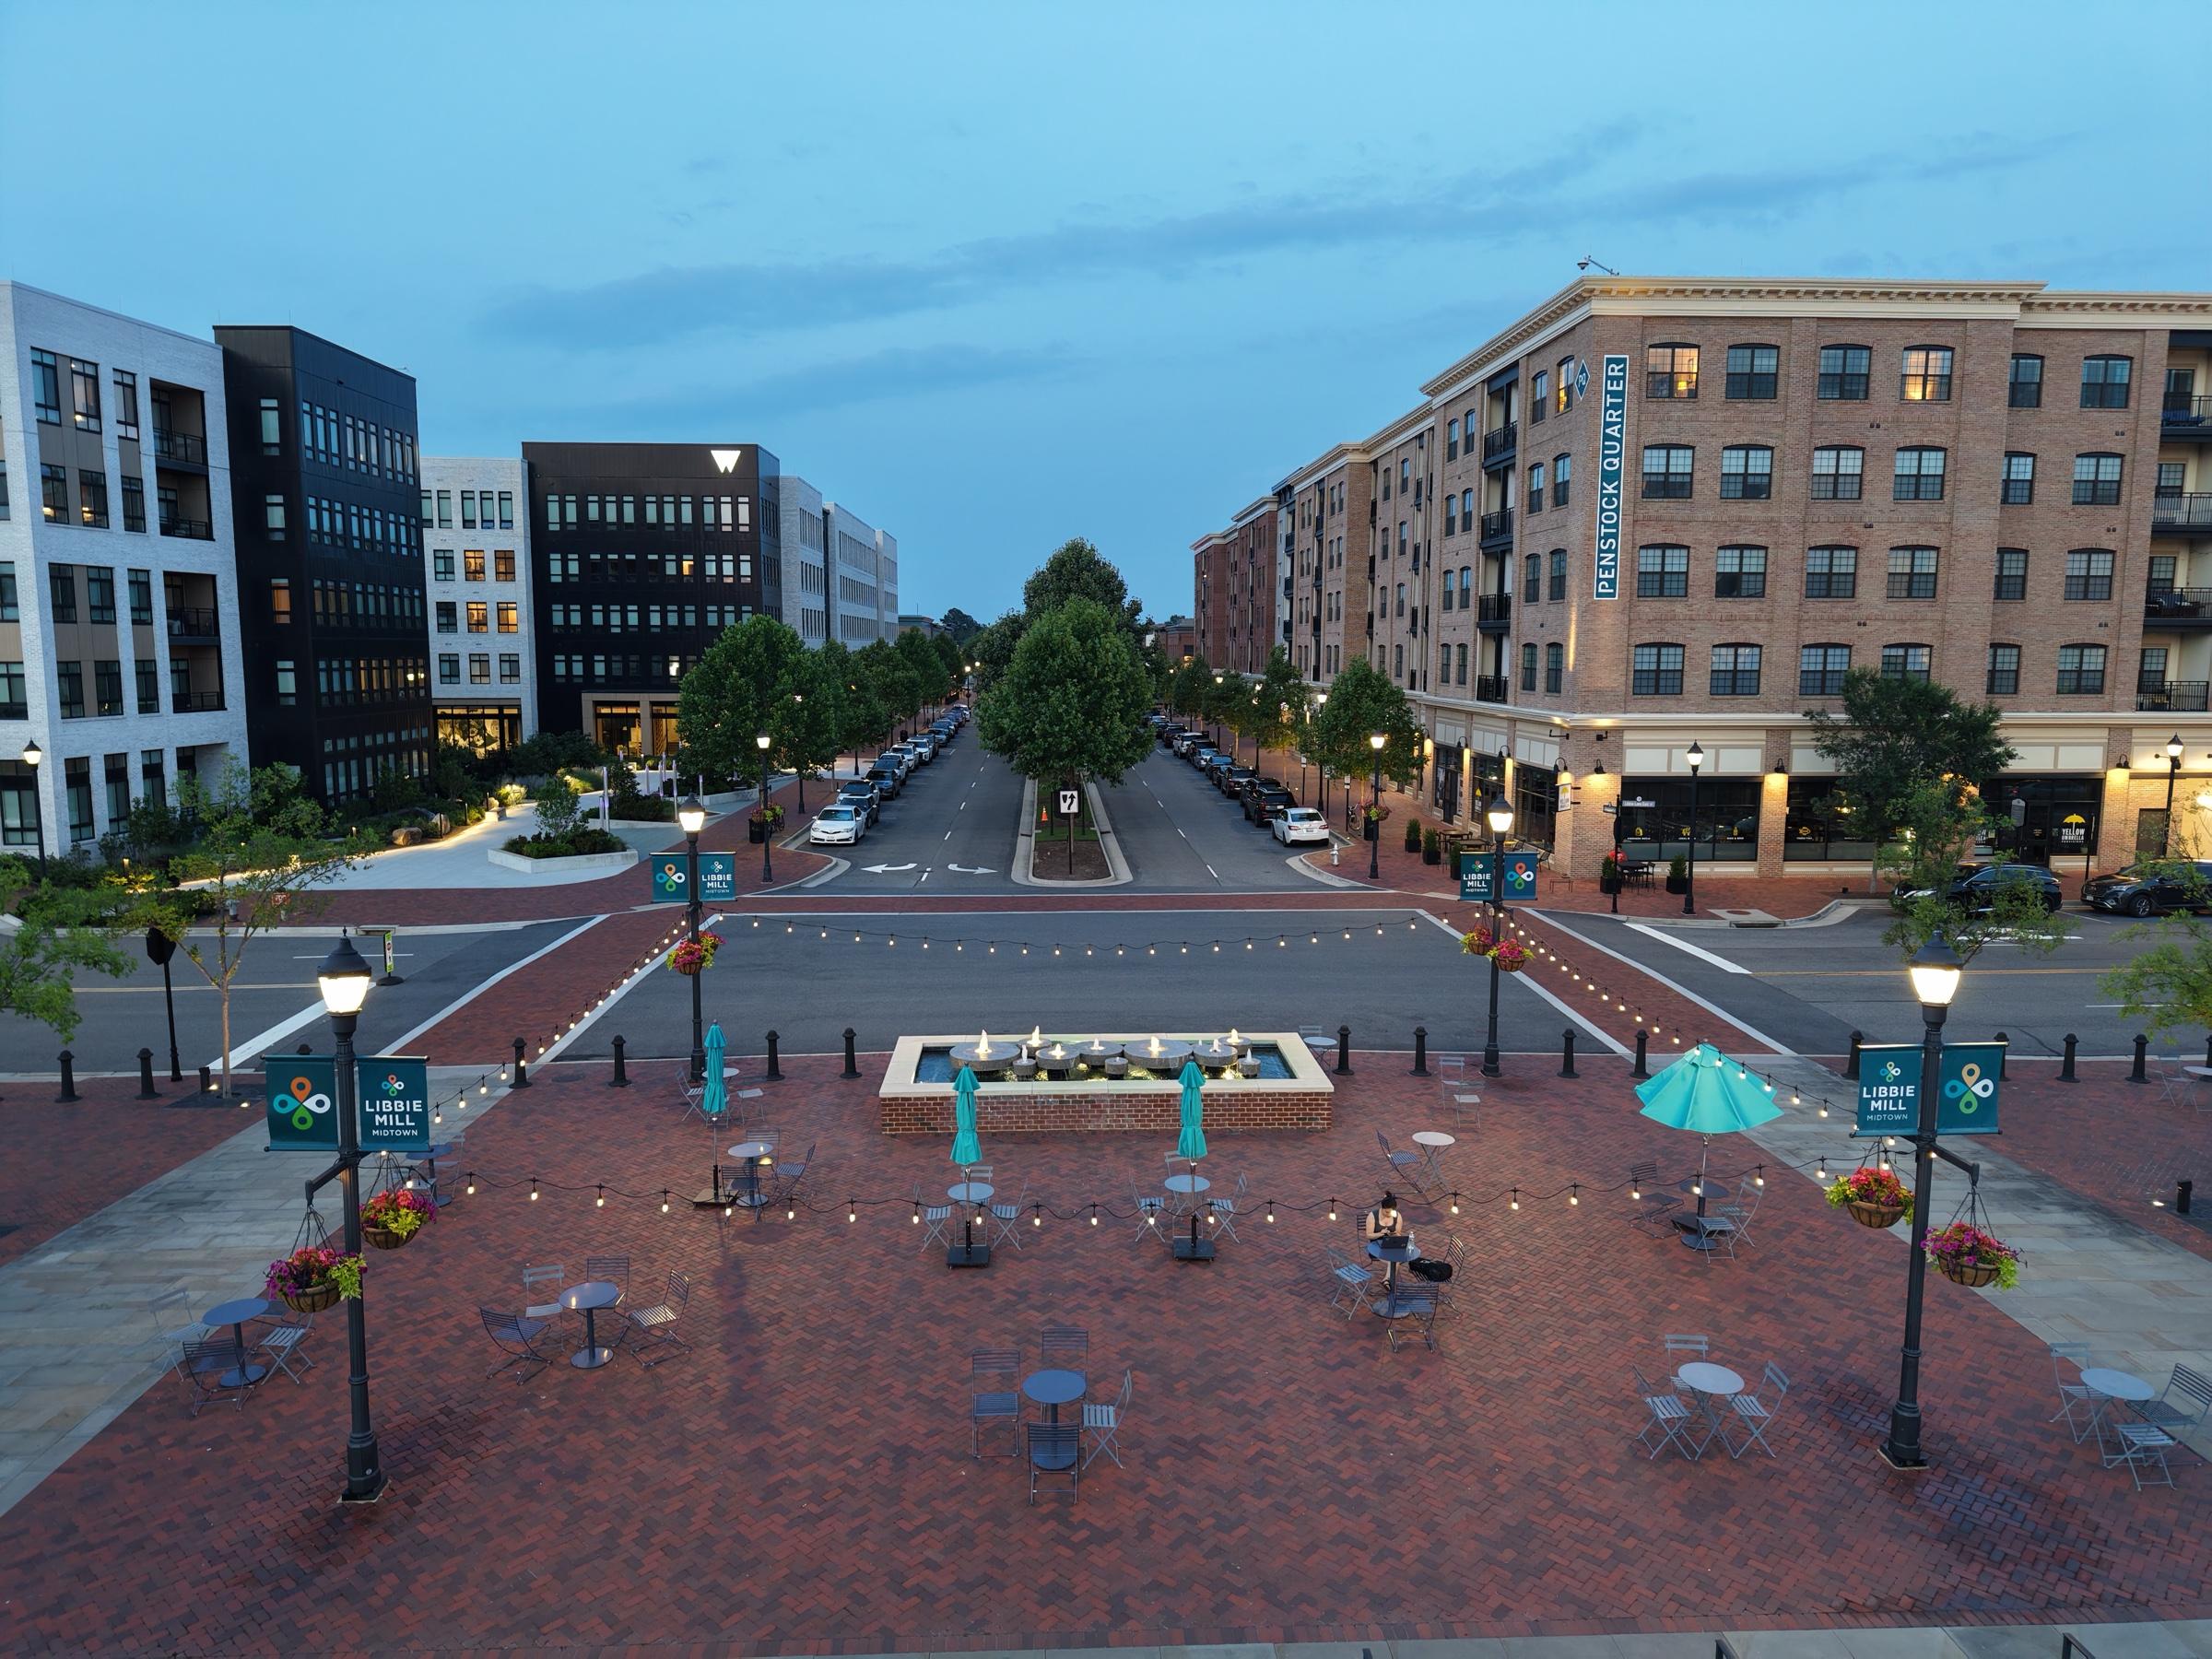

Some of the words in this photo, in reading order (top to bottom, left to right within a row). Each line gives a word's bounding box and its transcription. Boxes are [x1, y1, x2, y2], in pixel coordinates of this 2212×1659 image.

[1604, 363, 1624, 471] QUARTER
[1598, 480, 1618, 593] PENSTOCK
[1863, 1085, 1915, 1098] LIBBIE
[365, 1100, 423, 1112] LIBBIE
[1870, 1099, 1907, 1112] MILL
[374, 1113, 416, 1126] MILL
[1866, 1113, 1908, 1122] MIDTOWN
